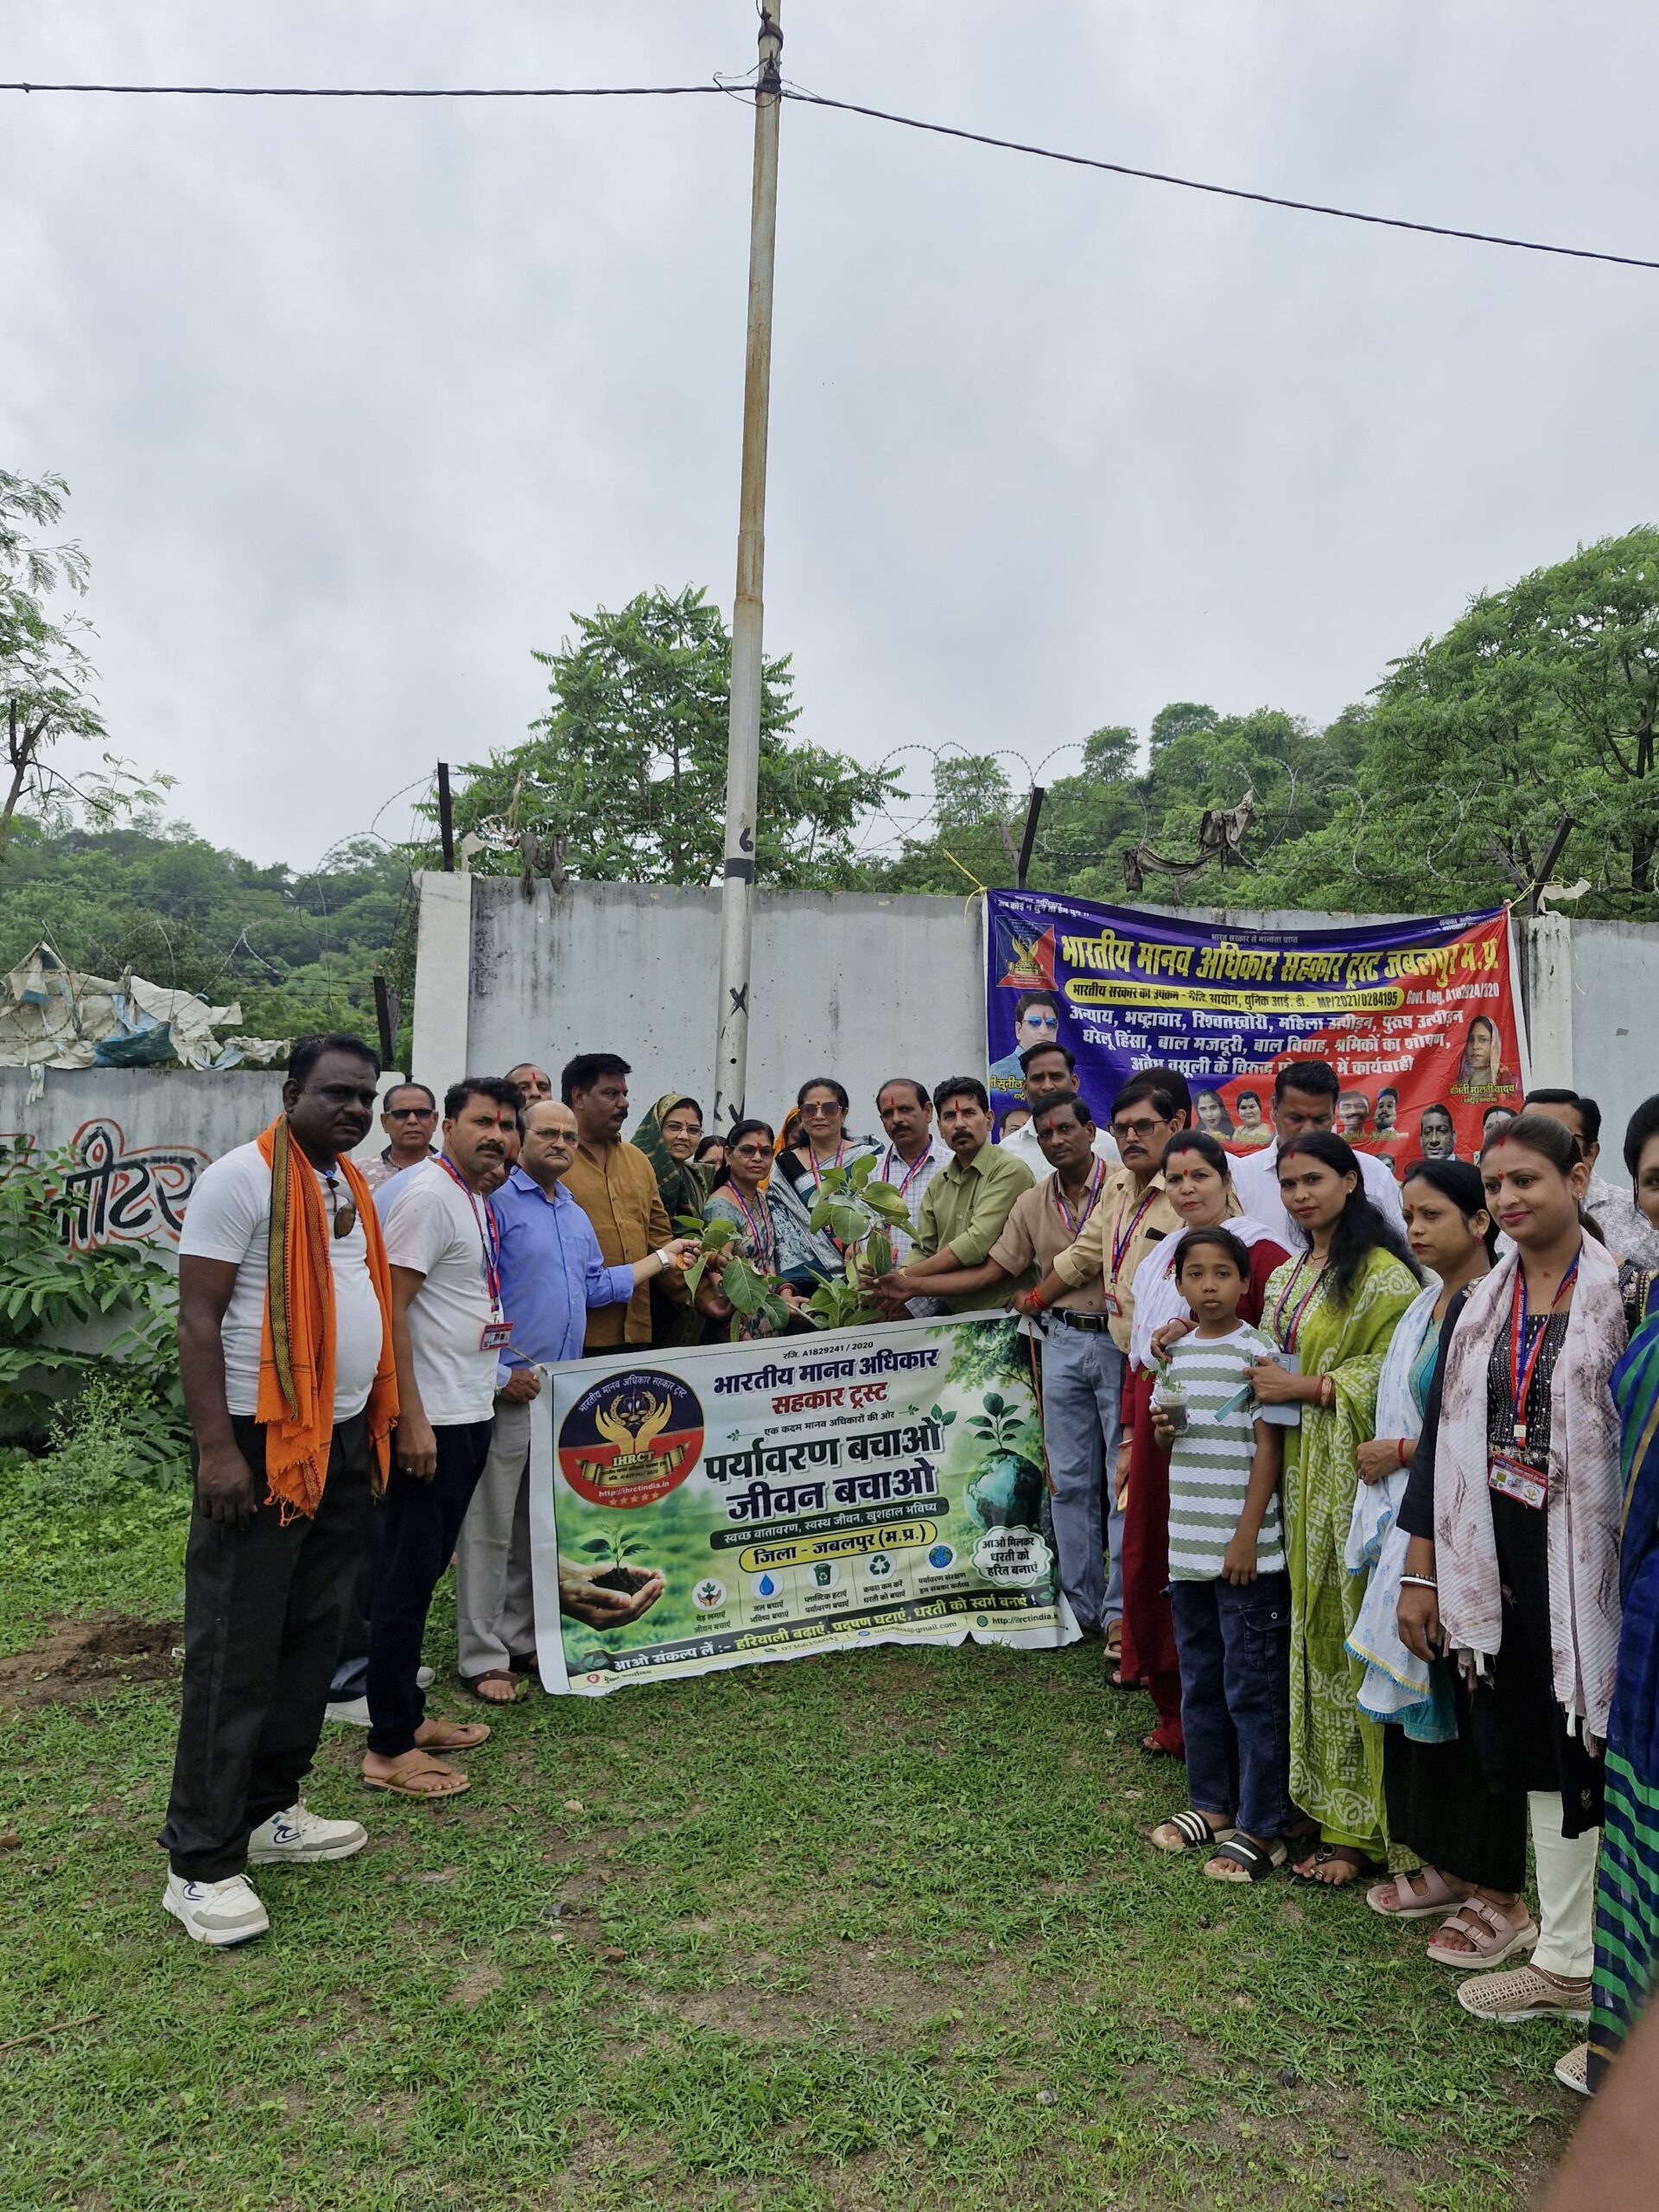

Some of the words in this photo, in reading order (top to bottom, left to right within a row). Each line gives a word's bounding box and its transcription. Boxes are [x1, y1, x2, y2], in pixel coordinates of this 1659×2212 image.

[1061, 929, 1134, 972] भारतीय
[1137, 942, 1195, 977] मानव
[1196, 941, 1281, 982] अधिकार
[1281, 951, 1348, 982] सहकार
[1345, 951, 1383, 989] ट्रस्ट
[1383, 944, 1459, 988] जबलपुर
[1073, 982, 1106, 997] भारतीय
[1109, 985, 1137, 999] सरकार
[1139, 988, 1150, 1000] का
[1154, 988, 1179, 1001] उपक्रम
[1209, 991, 1242, 1009] आयोग,
[1317, 992, 1397, 1009] MP/2021/0284195
[1427, 989, 1445, 1005] Reg.
[1070, 1005, 1118, 1027] अन्याय,
[1192, 1010, 1274, 1033] रिश्वतखोरी,
[1279, 1014, 1324, 1030] महिला
[1326, 1014, 1376, 1033] उत्पीड़न,
[1417, 1009, 1463, 1027] उत्पीड़न
[1083, 1028, 1116, 1051] घरेलू
[1115, 1029, 1152, 1052] हिंसा,
[1158, 1037, 1190, 1050] बाल
[1193, 1035, 1247, 1056] मजदूरी,
[1254, 1039, 1284, 1052] बाल
[1287, 1035, 1329, 1055] विवाह,
[1334, 1034, 1380, 1052] श्रमिकों
[1382, 1039, 1400, 1052] का
[1404, 1033, 1452, 1049] शोषण,
[1131, 1053, 1165, 1071] अवैध
[1168, 1057, 1210, 1078] वसूली
[1213, 1056, 1228, 1074] के
[1337, 1058, 1349, 1074] में
[1352, 1055, 1414, 1075] कार्यवाही
[1494, 1084, 1515, 1093] यादव
[802, 1344, 843, 1357] A1829241
[852, 1341, 874, 1351] 2020
[714, 1363, 794, 1394] भारतीय
[798, 1358, 855, 1382] मानव
[859, 1348, 938, 1376] अधिकार
[578, 1389, 601, 1413] भारतीय
[601, 1380, 620, 1394] मानव
[623, 1374, 652, 1386] अधिकार
[652, 1376, 676, 1391] सहकार
[673, 1386, 688, 1399] ट्रस्ट
[772, 1387, 844, 1414] सहकार
[849, 1382, 888, 1408] ट्रस्ट
[764, 1427, 779, 1435] एक
[780, 1424, 802, 1433] कदम
[804, 1421, 827, 1430] मानव
[830, 1414, 865, 1426] अधिकारों
[867, 1412, 879, 1422] की
[880, 1410, 895, 1419] ओर
[703, 1438, 841, 1482] पर्यावरण
[845, 1416, 942, 1460] बचाओ
[613, 1452, 654, 1466] IHRCT
[599, 1480, 670, 1497] http://ihrctindia.in
[726, 1481, 826, 1520] जीवन
[833, 1458, 937, 1503] बचाओ
[724, 1531, 751, 1543] स्वच्छ
[753, 1523, 802, 1540] वातावरण,
[804, 1518, 831, 1530] स्वस्थ
[833, 1512, 863, 1527] जीवन,
[866, 1506, 904, 1523] खुशहाल
[906, 1501, 938, 1515] भविष्य
[753, 1547, 796, 1566] जिला
[812, 1533, 875, 1554] जबलपुर
[879, 1524, 926, 1547] (म.प्र.)
[982, 1536, 1007, 1549] आओ
[1007, 1535, 1034, 1546] मिलकर
[991, 1550, 1014, 1561] धरती
[1017, 1548, 1030, 1560] को
[918, 1574, 943, 1584] पर्यावरण
[945, 1572, 966, 1580] संरक्षण
[986, 1564, 1010, 1576] हरित
[804, 1592, 830, 1602] प्लास्टिक
[864, 1594, 879, 1603] धरती
[880, 1592, 888, 1600] को
[753, 1604, 766, 1612] जल
[804, 1604, 831, 1613] पर्यावरण
[750, 1614, 771, 1624] भविष्य
[614, 1656, 649, 1671] आओ
[652, 1646, 698, 1664] संकल्प
[700, 1642, 714, 1656] लें
[735, 1628, 790, 1651] हरियाली
[831, 1617, 872, 1633] प्रदूषण
[913, 1599, 946, 1618] धरती
[949, 1596, 968, 1611] को
[969, 1593, 996, 1608] स्वर्ग
[694, 1625, 713, 1634] जीवन
